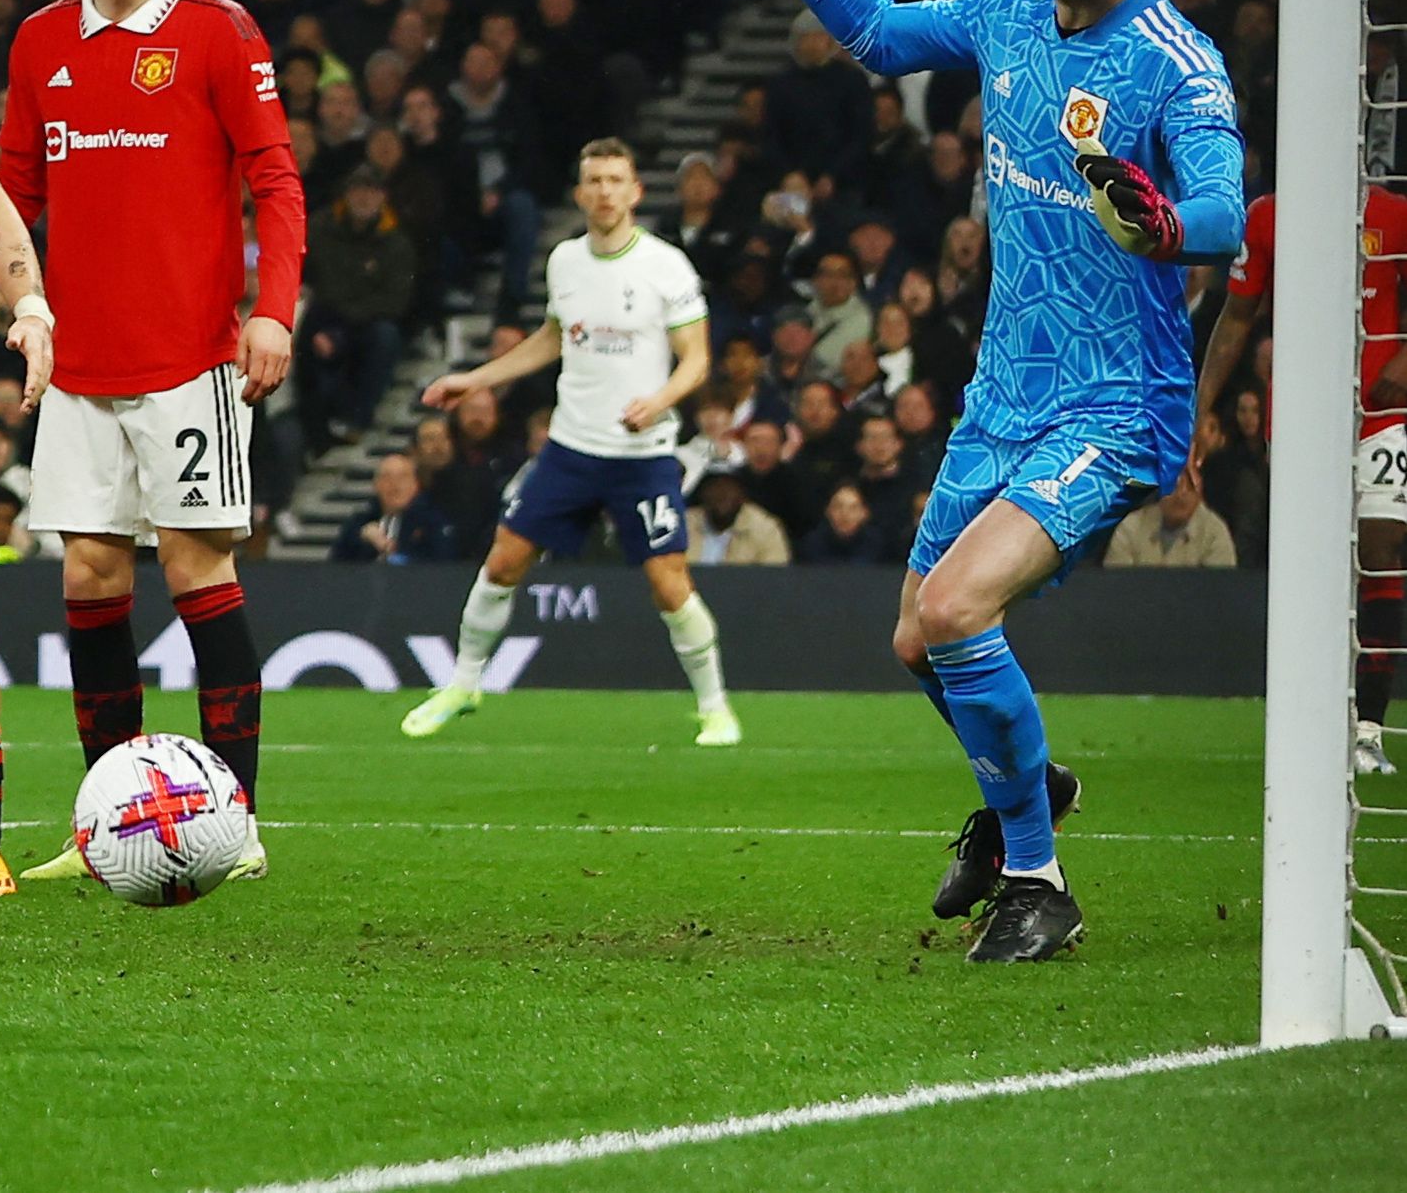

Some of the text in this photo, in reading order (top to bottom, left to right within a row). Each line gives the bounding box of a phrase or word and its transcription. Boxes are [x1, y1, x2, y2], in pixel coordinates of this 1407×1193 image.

[67, 128, 168, 149] TeamViewer
[1005, 159, 1095, 215] TeamViewe
[175, 428, 211, 482] 2
[1058, 442, 1102, 486] 1
[636, 494, 679, 536] 14
[528, 584, 599, 622] TM
